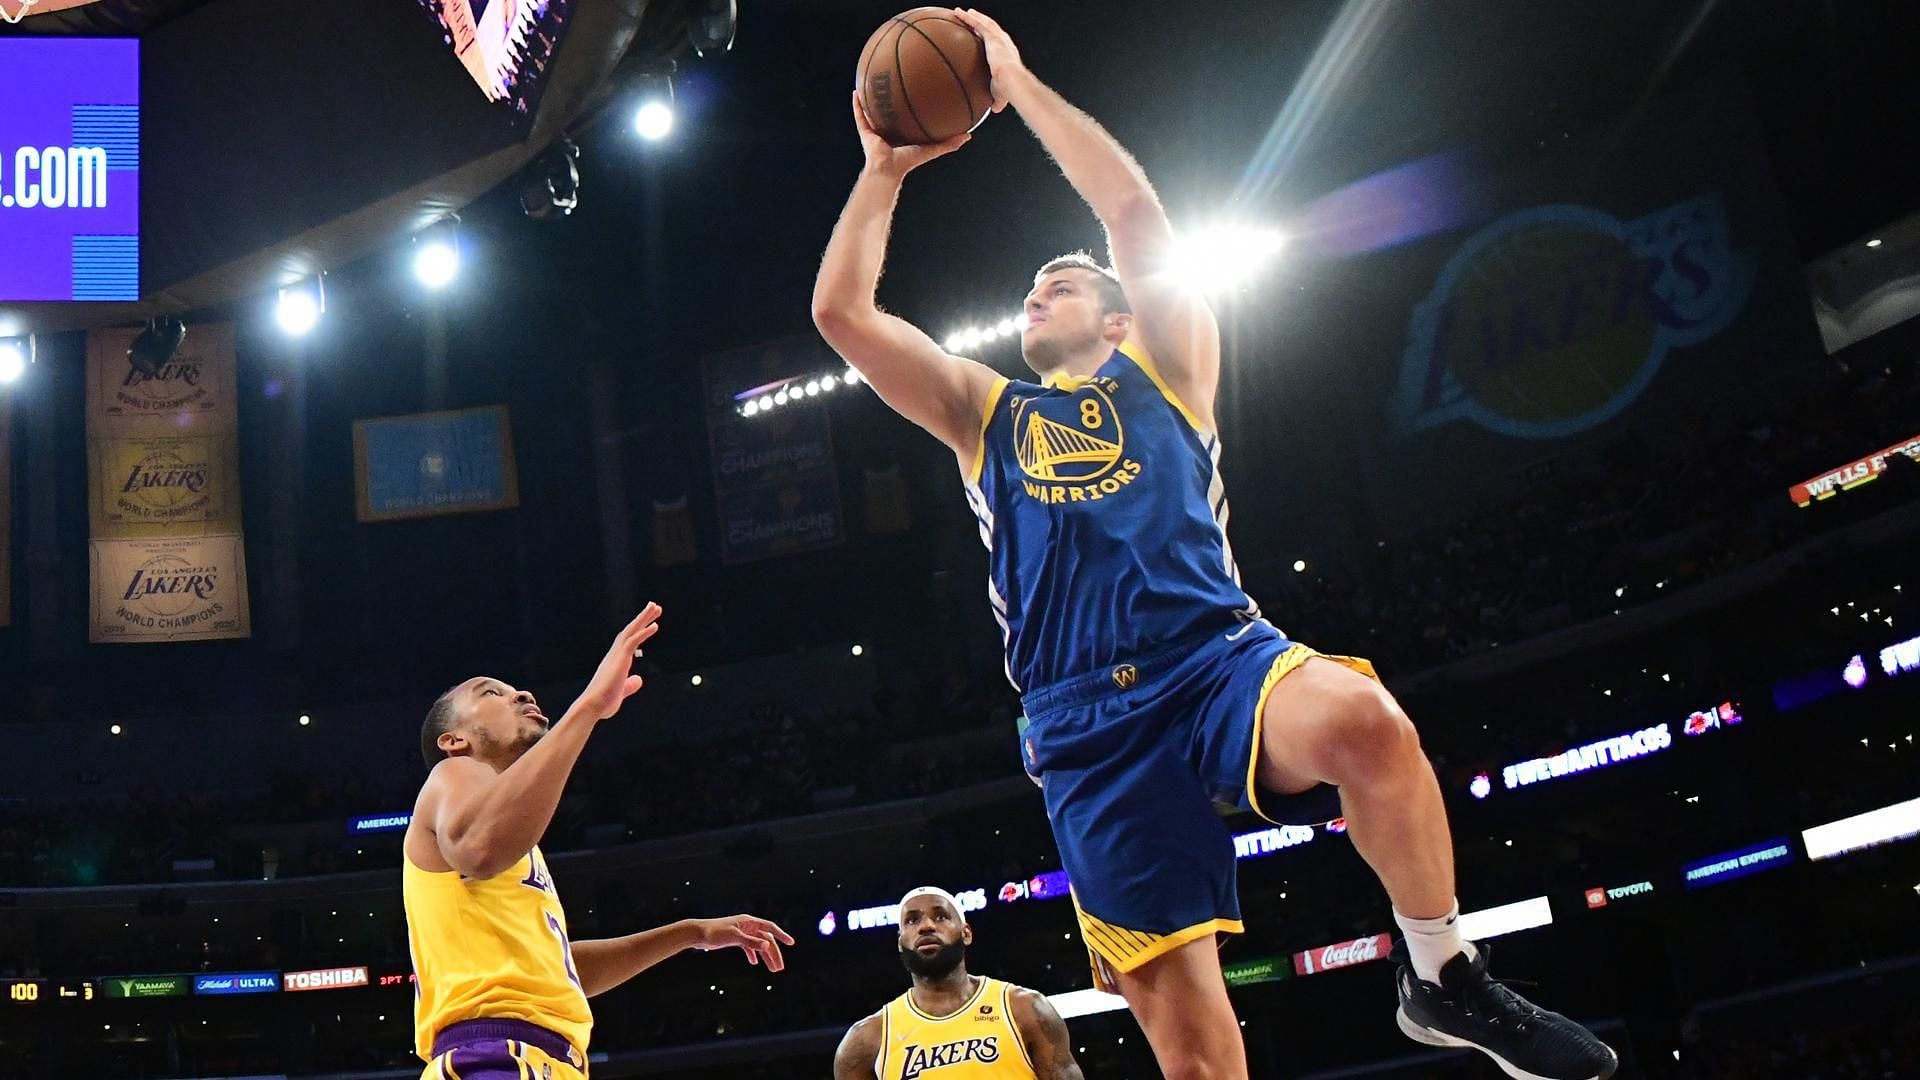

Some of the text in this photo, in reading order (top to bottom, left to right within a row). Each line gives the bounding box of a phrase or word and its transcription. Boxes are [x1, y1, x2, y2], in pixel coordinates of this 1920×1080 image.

[0, 146, 107, 208] .com
[1080, 398, 1103, 429] 8
[119, 465, 208, 492] LAKERS
[1022, 459, 1142, 504] WARRIORS
[1804, 461, 1869, 496] WELLS
[118, 495, 210, 518] WORLD CHAMPIONS
[120, 570, 217, 600] LAKERS
[116, 602, 224, 629] WORLD CHAMPIONS
[1502, 722, 1672, 790] #WEWANTTACOS
[356, 816, 408, 830] AMERICAN
[1686, 845, 1788, 881] AMERICAN EXPRESS
[1606, 880, 1654, 900] TOYOTA
[10, 983, 39, 1001] 100
[239, 978, 275, 988] ULTRA
[285, 969, 367, 988] TOSHIBA
[380, 975, 403, 986] 3PT
[84, 987, 93, 1000] 3
[901, 1037, 999, 1080] LAKERS
